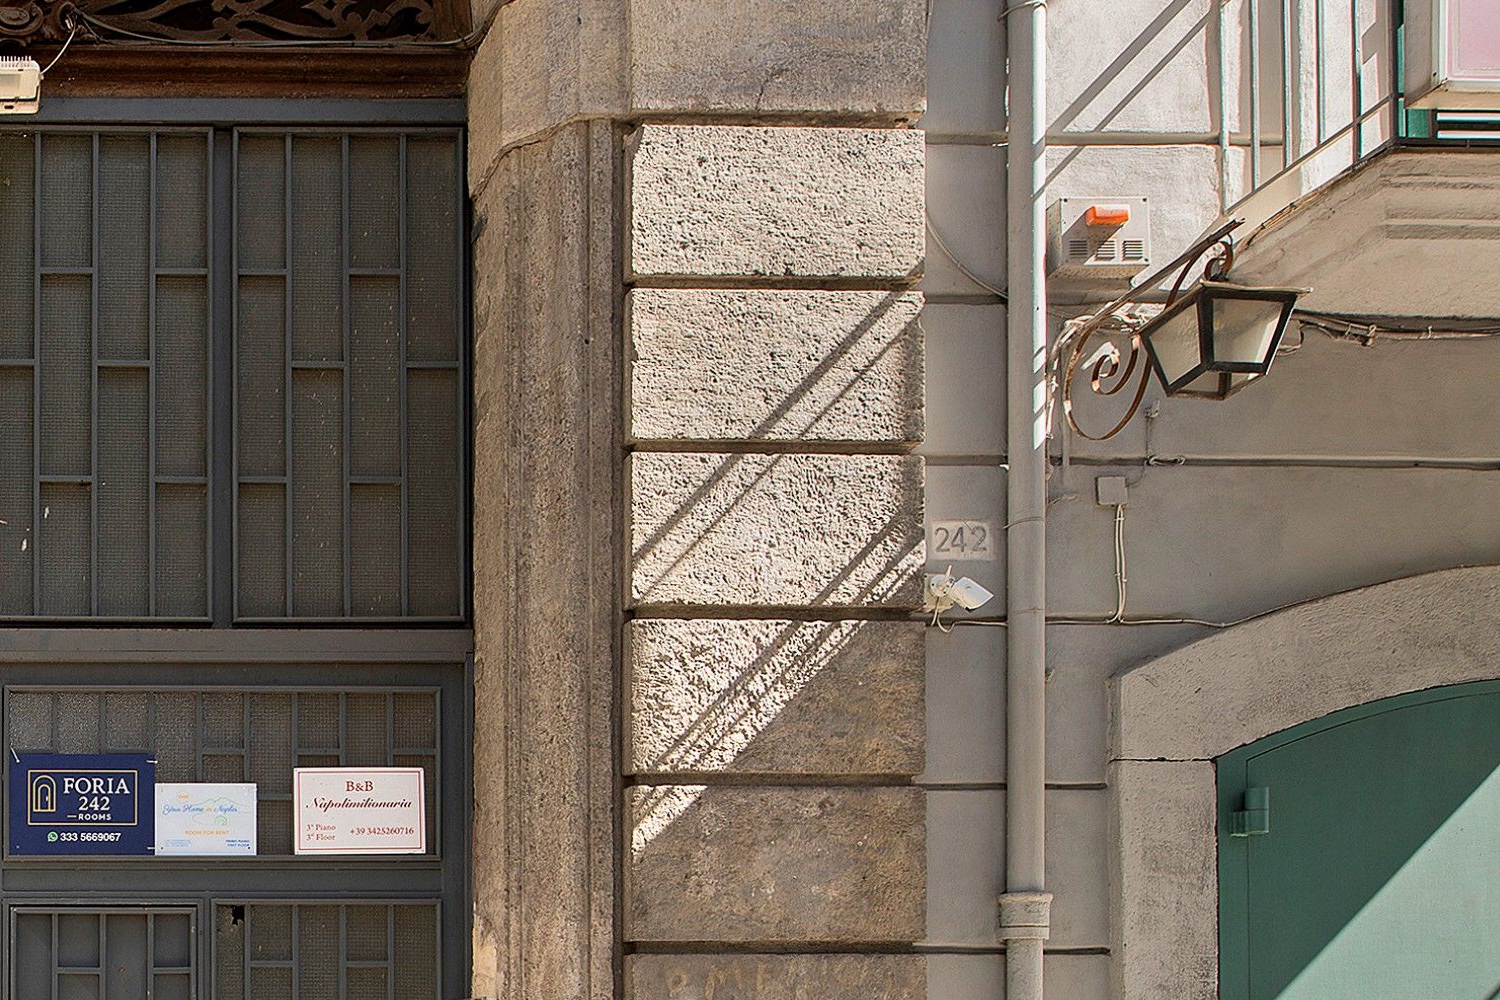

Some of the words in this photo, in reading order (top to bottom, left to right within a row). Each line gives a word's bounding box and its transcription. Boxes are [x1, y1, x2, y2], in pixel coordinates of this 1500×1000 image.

[935, 526, 987, 552] 242
[63, 777, 130, 794] FORIA
[346, 781, 374, 792] B&B
[78, 796, 110, 811] 242
[306, 797, 412, 812] Napolimilionaria
[78, 813, 112, 821] ROOMS
[60, 832, 78, 842] 333
[80, 832, 121, 842] 5669067
[350, 828, 366, 836] +39
[367, 827, 414, 836] 3425260716
